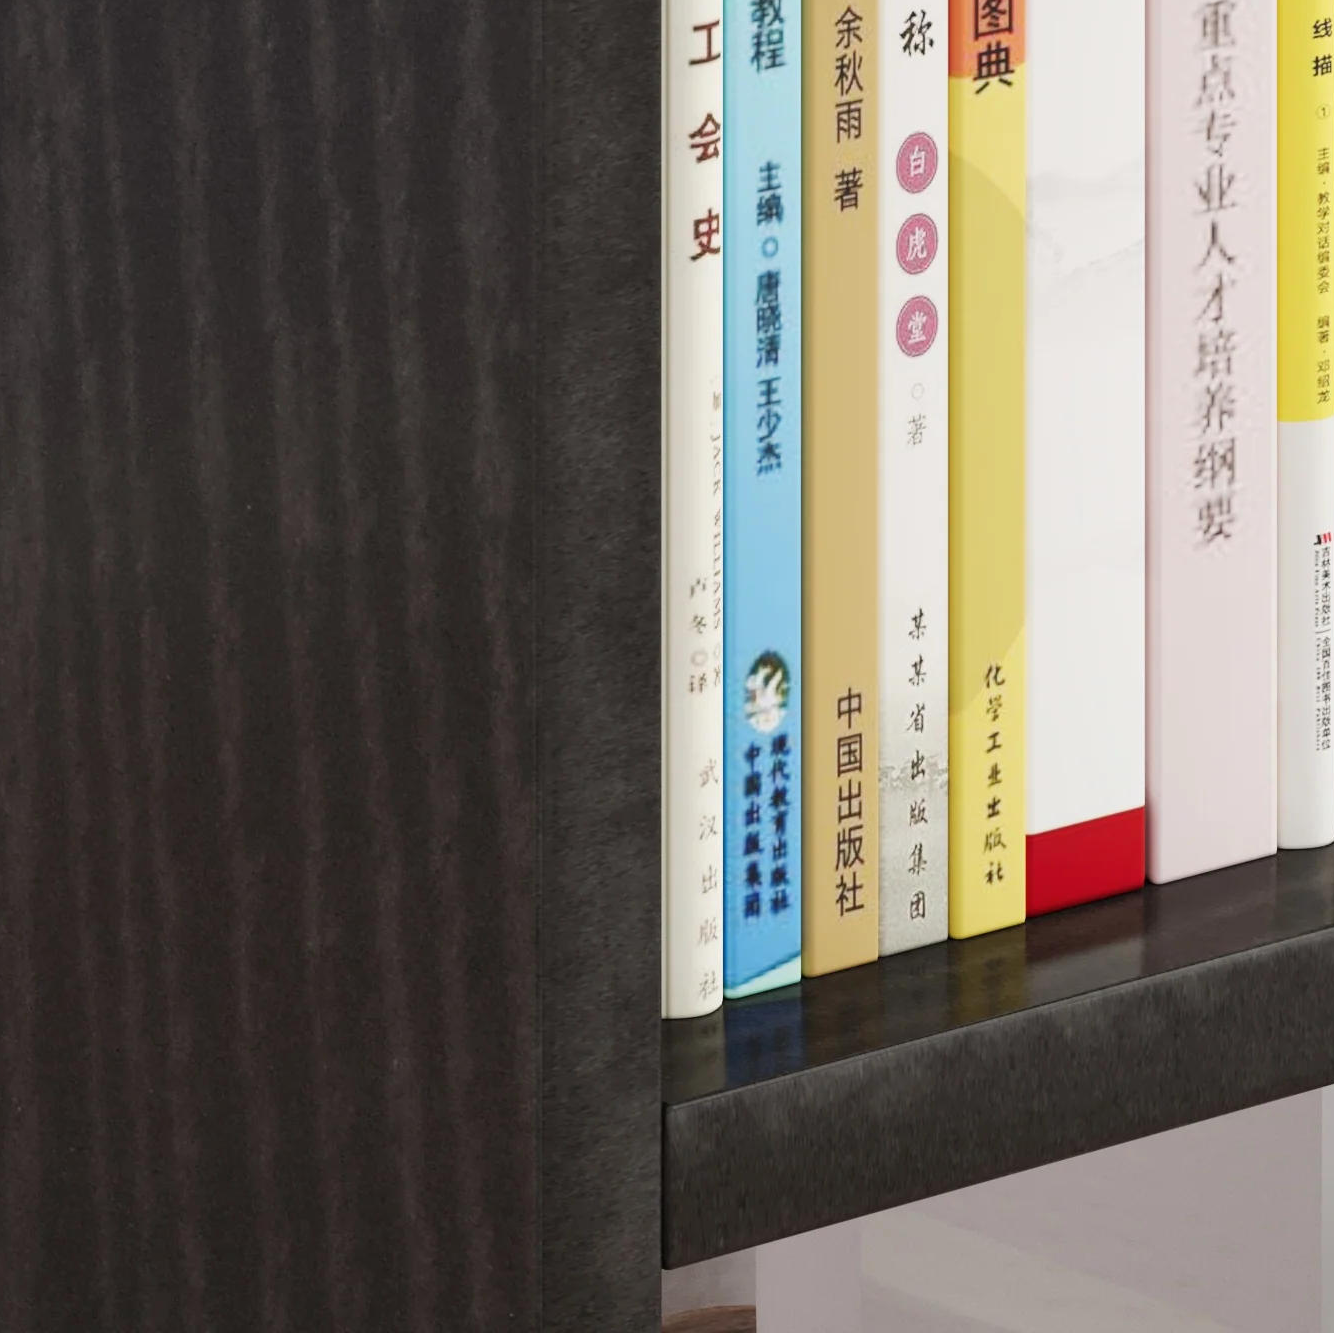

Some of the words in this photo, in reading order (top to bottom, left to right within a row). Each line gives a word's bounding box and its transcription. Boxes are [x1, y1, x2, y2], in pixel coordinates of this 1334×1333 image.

[834, 5, 864, 143] 余秋雨
[1312, 18, 1333, 77] 线描
[834, 167, 863, 212] 著
[835, 687, 865, 916] 中国出版社
